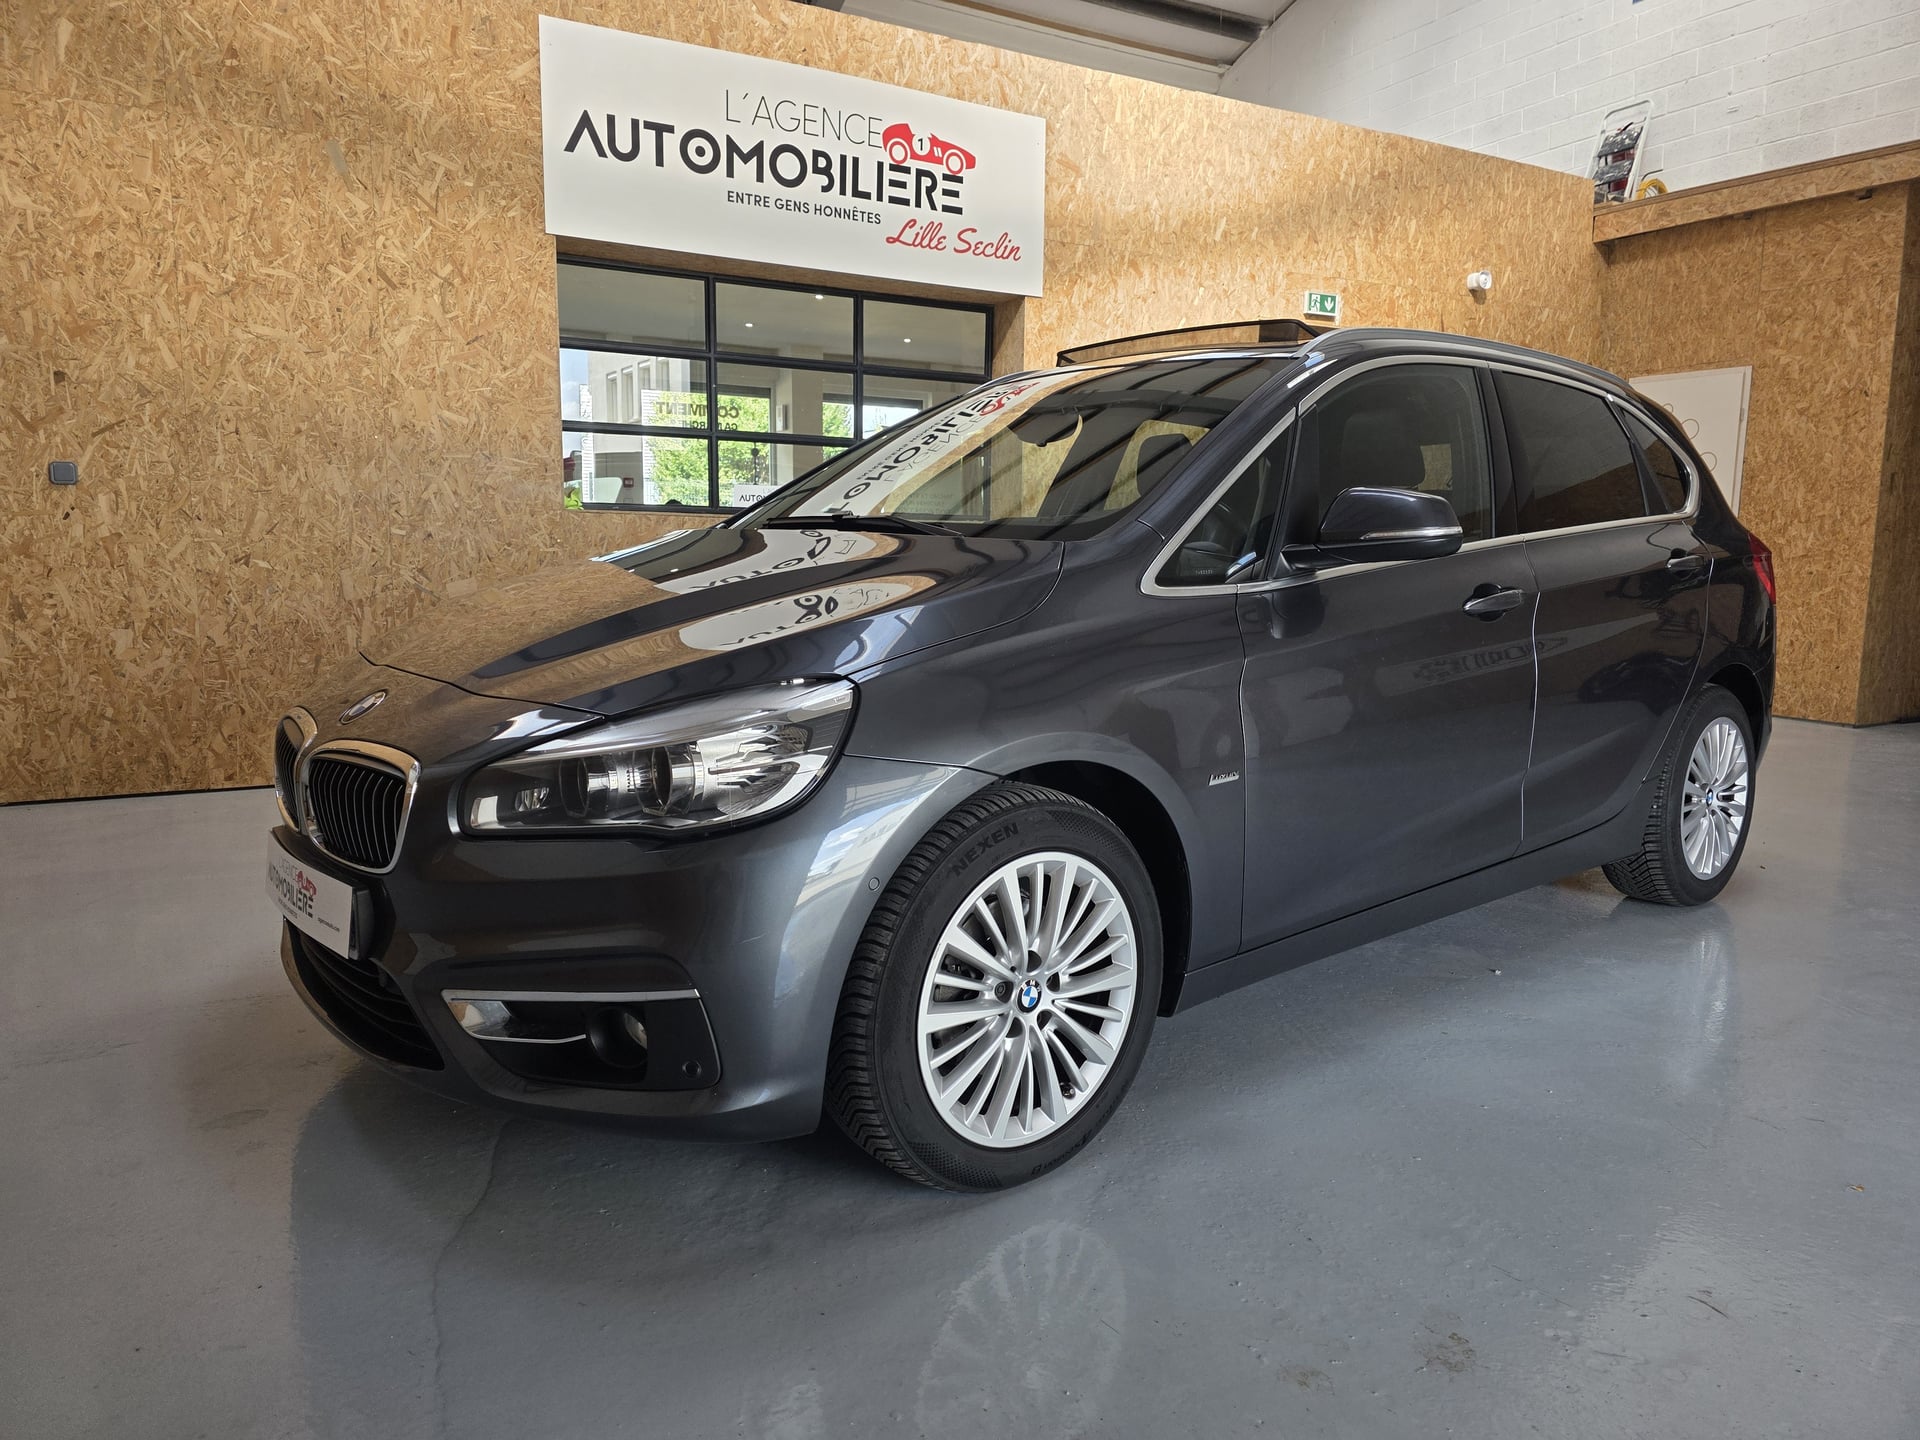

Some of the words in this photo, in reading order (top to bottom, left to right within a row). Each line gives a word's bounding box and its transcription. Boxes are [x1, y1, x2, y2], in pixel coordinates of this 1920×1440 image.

[564, 109, 964, 215] AUTOMOBILIERE
[917, 137, 926, 152] 1
[727, 190, 771, 208] ENTRE
[774, 198, 810, 214] GENS
[814, 203, 882, 225] HONNÊTES
[885, 218, 947, 251] Lille
[953, 227, 1022, 262] Seclin
[739, 494, 767, 502] AUTO
[951, 822, 1019, 876] NEXEN
